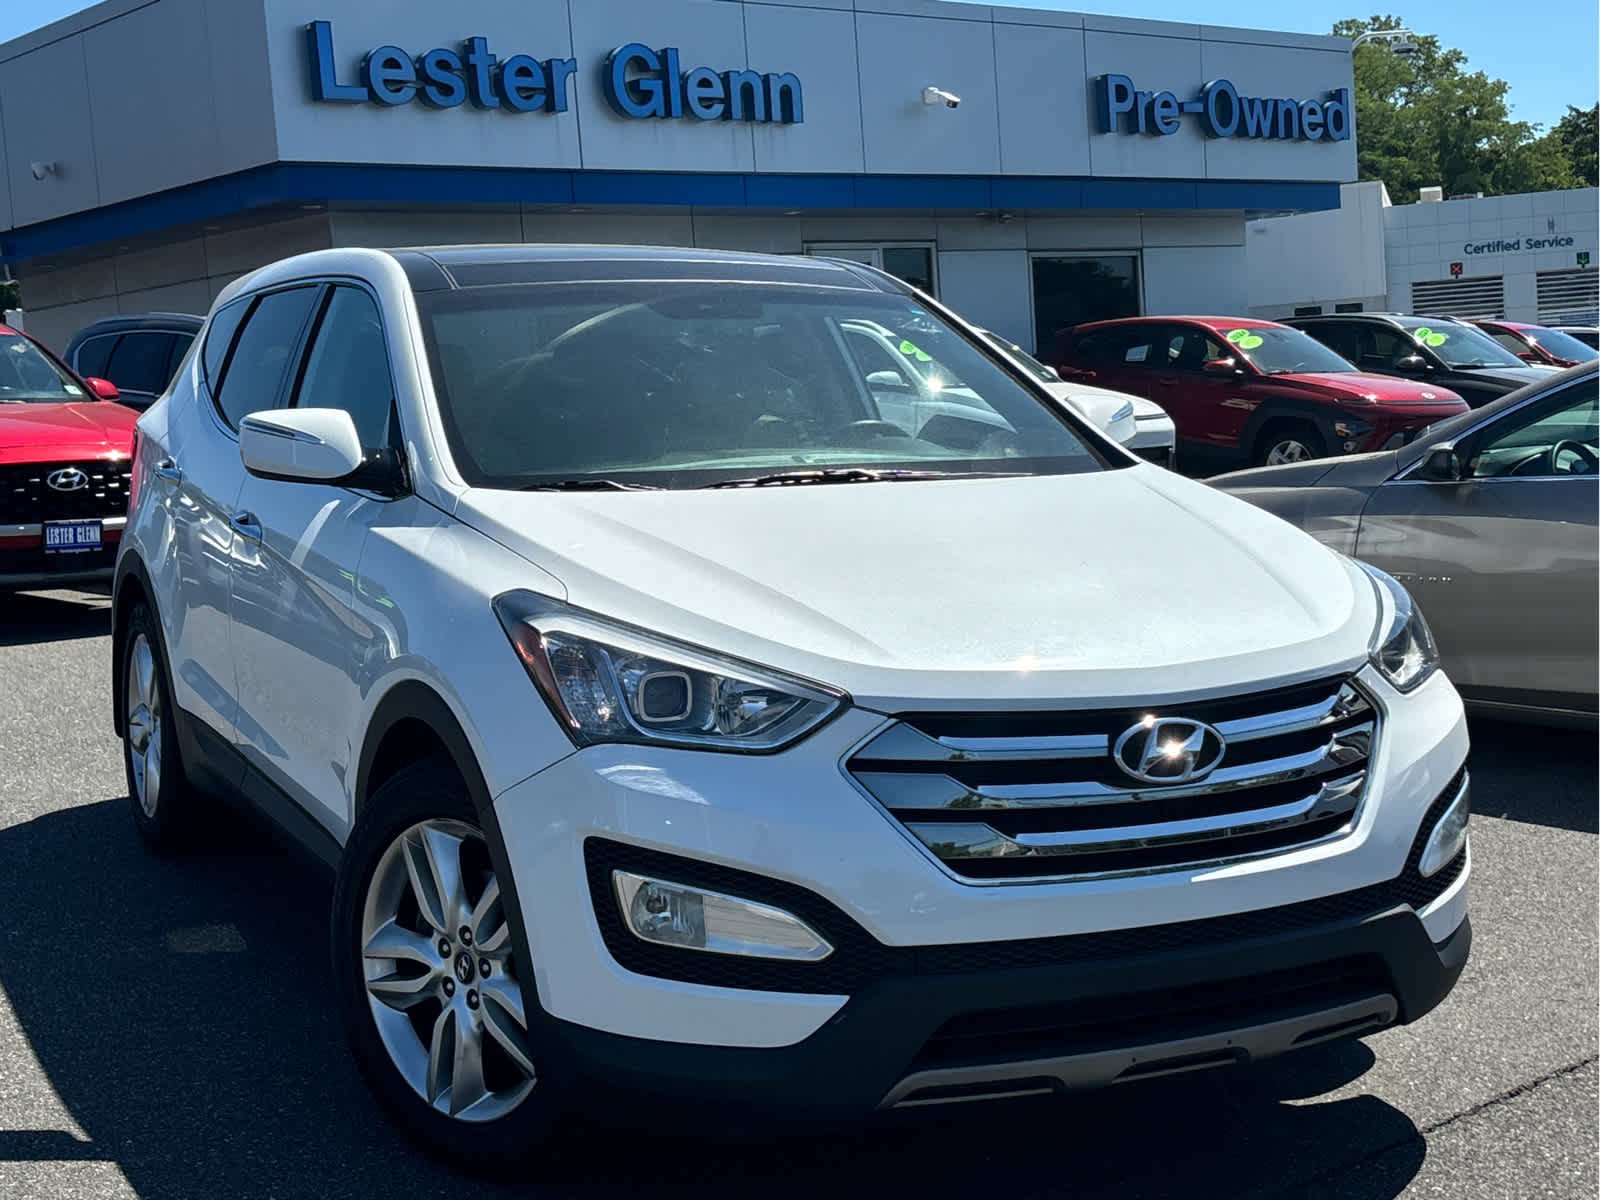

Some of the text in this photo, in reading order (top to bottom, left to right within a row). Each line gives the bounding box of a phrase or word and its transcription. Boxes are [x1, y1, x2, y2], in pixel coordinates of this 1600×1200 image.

[304, 20, 804, 124] Lester Glenn
[1096, 73, 1351, 141] Pre-Owned
[1463, 235, 1574, 255] Certified Service
[46, 526, 101, 544] LESTER GLENN
